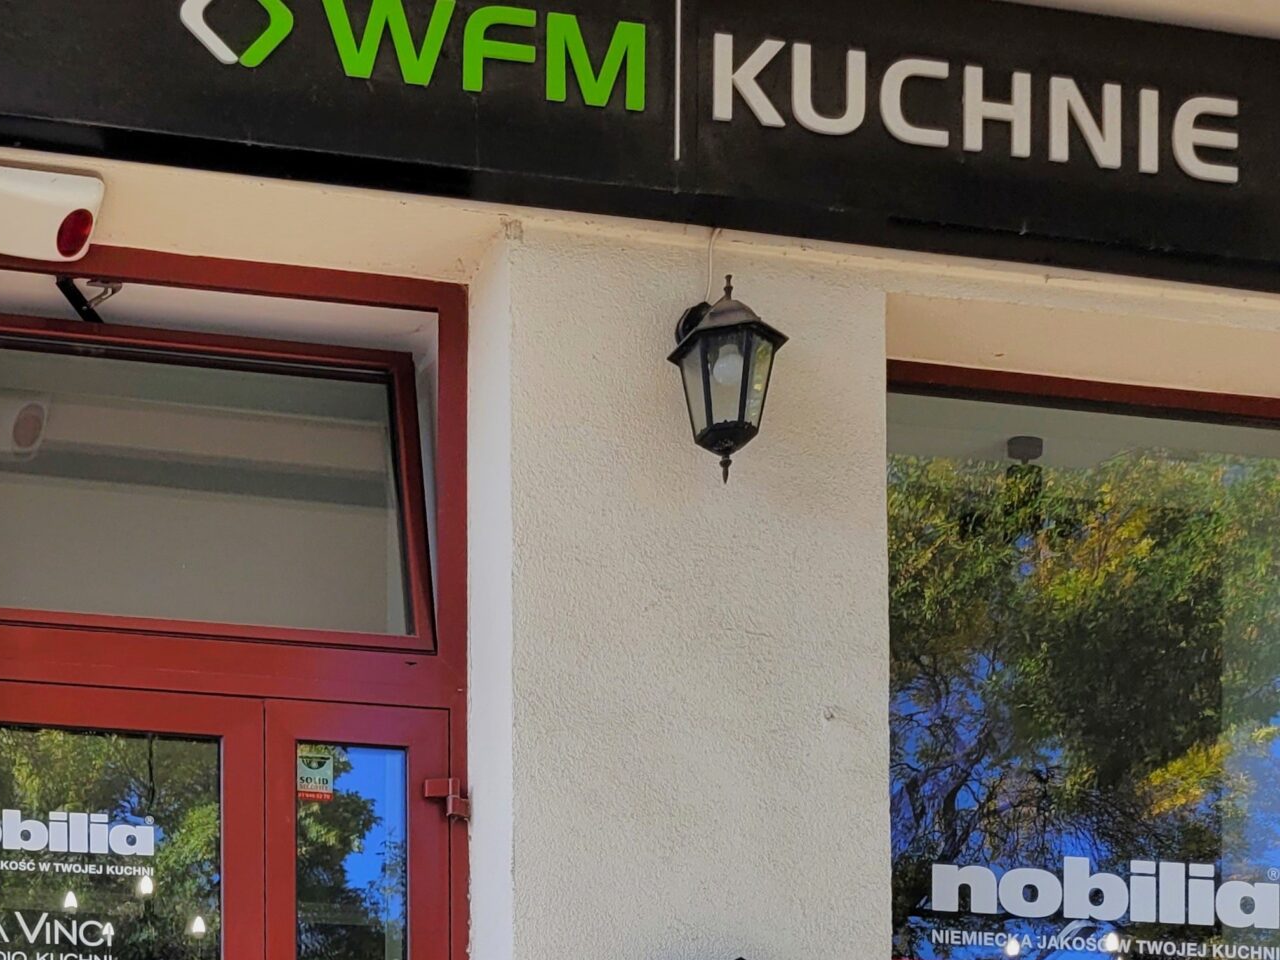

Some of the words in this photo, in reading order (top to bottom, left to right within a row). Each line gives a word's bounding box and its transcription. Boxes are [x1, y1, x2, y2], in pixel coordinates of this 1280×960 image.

[323, 0, 646, 112] WFM
[712, 32, 1239, 184] KUCHNIE
[38, 861, 52, 872] W
[53, 862, 104, 875] TWOJEJ
[106, 865, 154, 877] KUCHNI
[1115, 938, 1132, 954] W
[1135, 939, 1207, 957] TWOJEJ
[1212, 943, 1280, 960] KUCHNI
